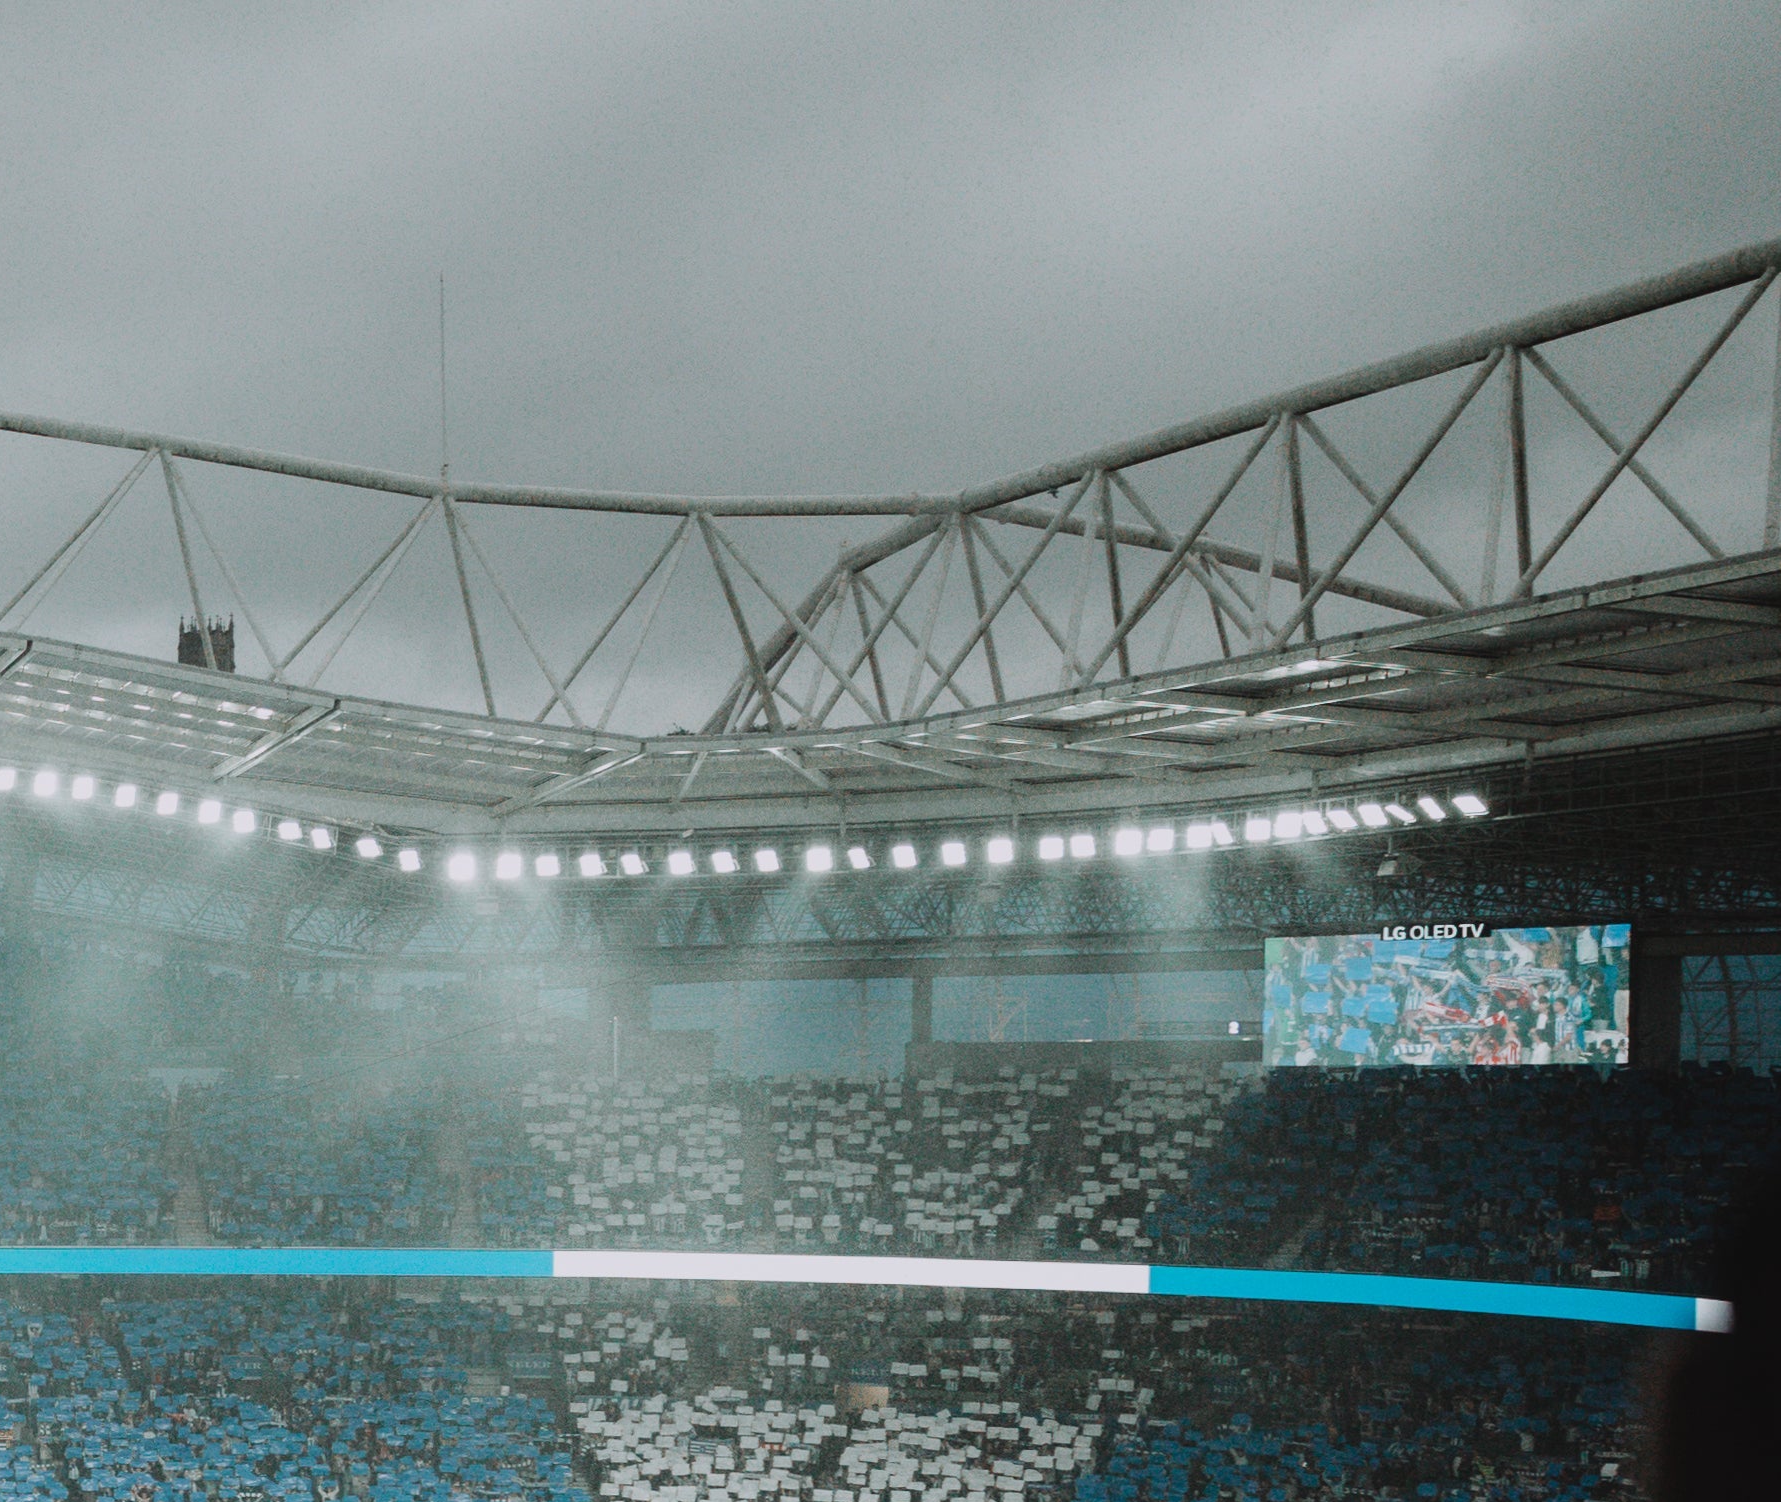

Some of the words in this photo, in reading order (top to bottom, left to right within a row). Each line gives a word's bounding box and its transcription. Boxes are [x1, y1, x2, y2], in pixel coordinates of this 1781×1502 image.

[1382, 926, 1406, 941] LG
[1409, 924, 1458, 940] OLED
[1459, 923, 1484, 938] TV
